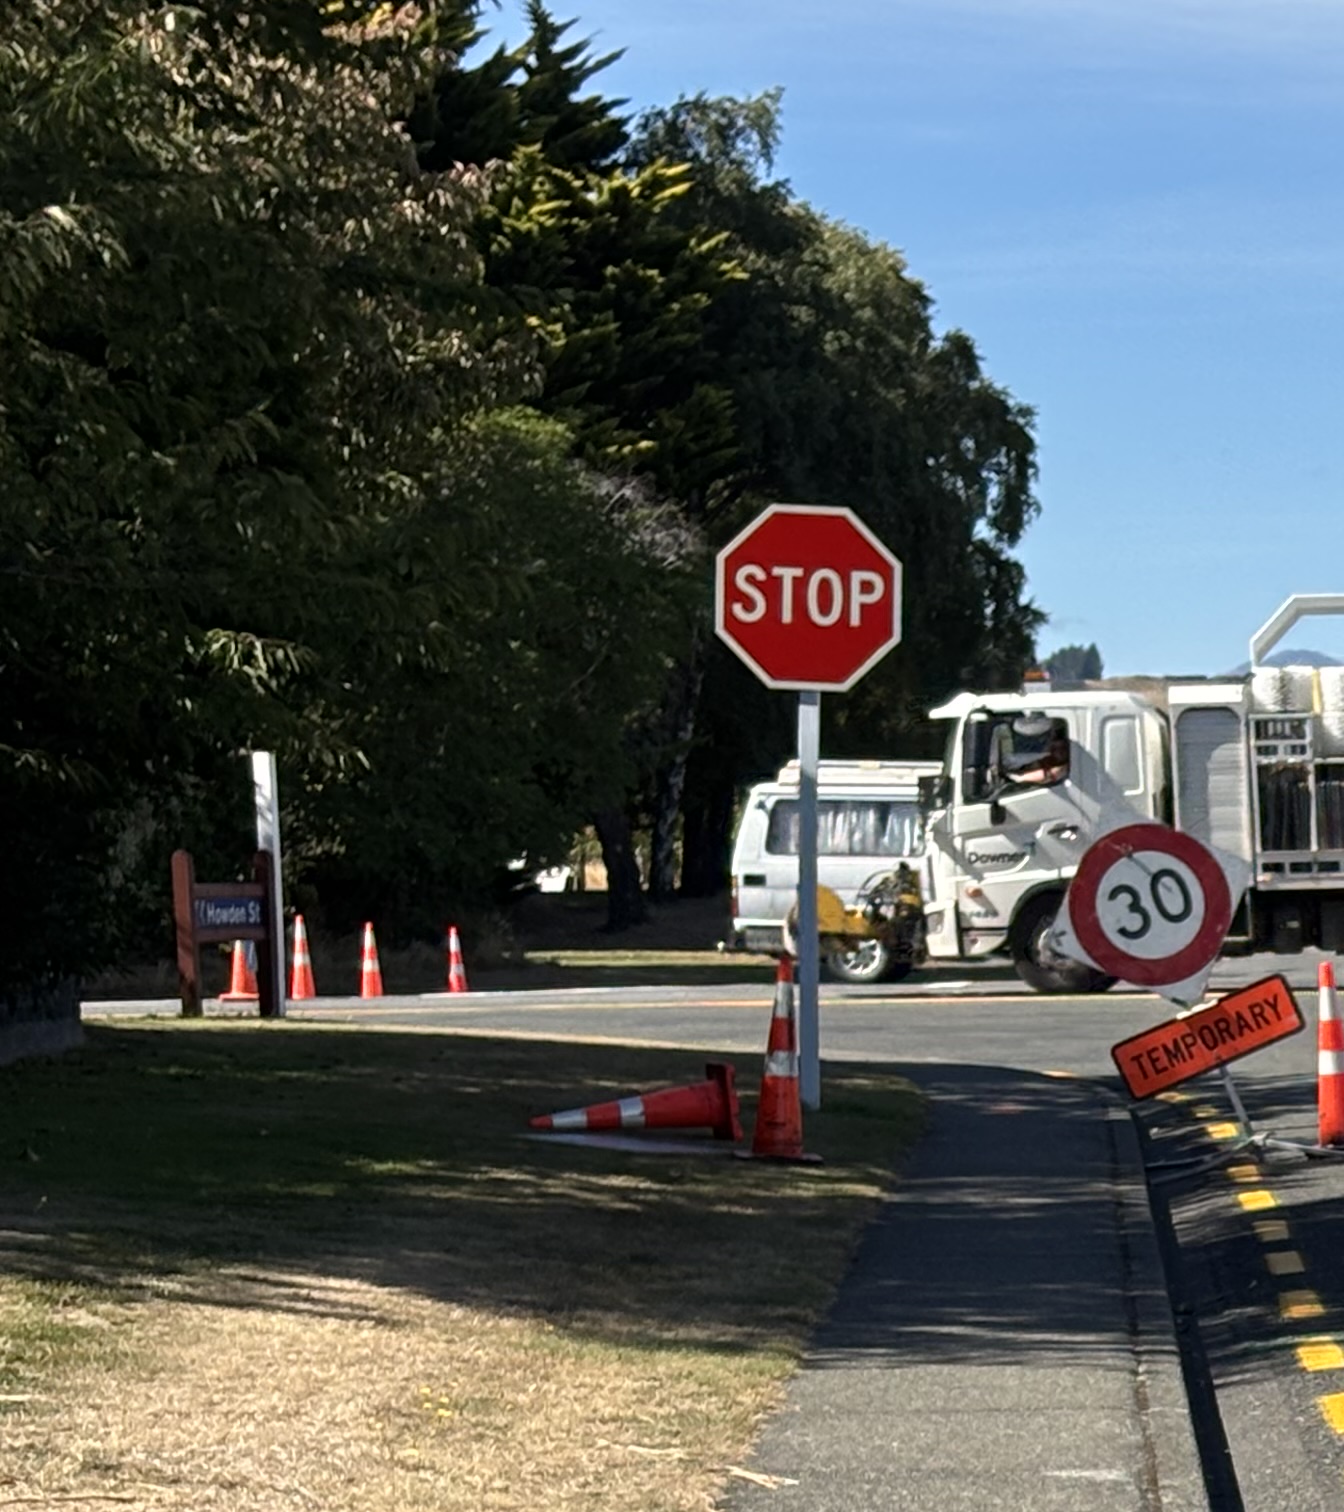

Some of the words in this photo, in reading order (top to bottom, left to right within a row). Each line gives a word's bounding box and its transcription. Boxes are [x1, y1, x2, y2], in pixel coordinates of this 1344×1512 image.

[731, 564, 885, 628] STOP
[967, 851, 1027, 865] Downer
[207, 902, 247, 925] Howden
[248, 900, 261, 924] St
[1107, 868, 1193, 940] 30
[1130, 994, 1284, 1080] TEMPORARY
